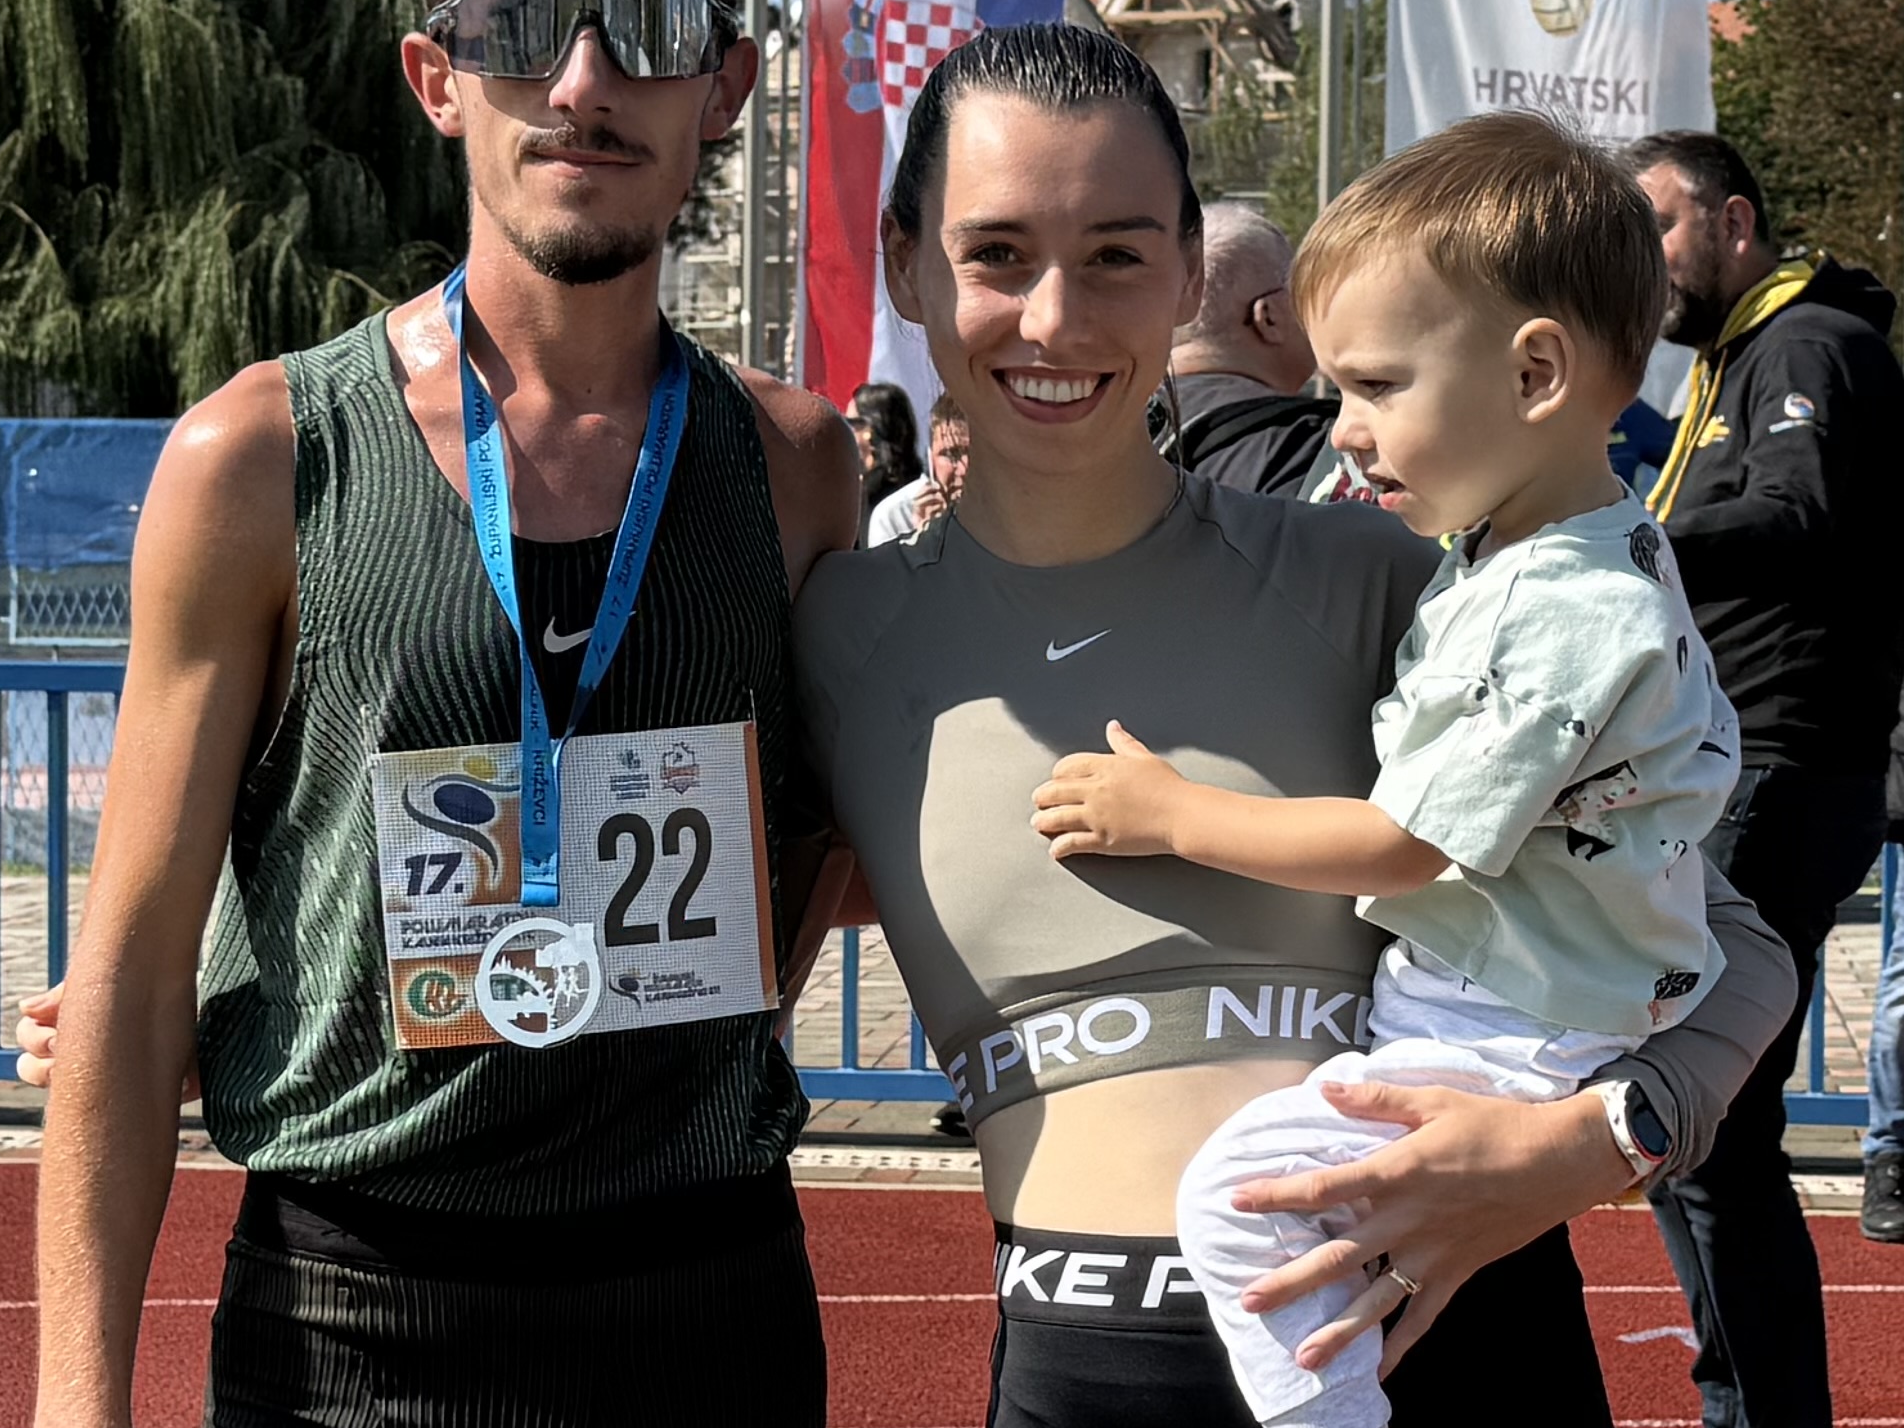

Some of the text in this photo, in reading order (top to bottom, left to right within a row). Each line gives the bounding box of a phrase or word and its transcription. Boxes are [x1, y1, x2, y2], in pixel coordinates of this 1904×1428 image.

[1473, 67, 1650, 116] HRVATSKI
[405, 851, 464, 896] 17.
[597, 808, 717, 947] 22
[979, 997, 1151, 1094] PRO
